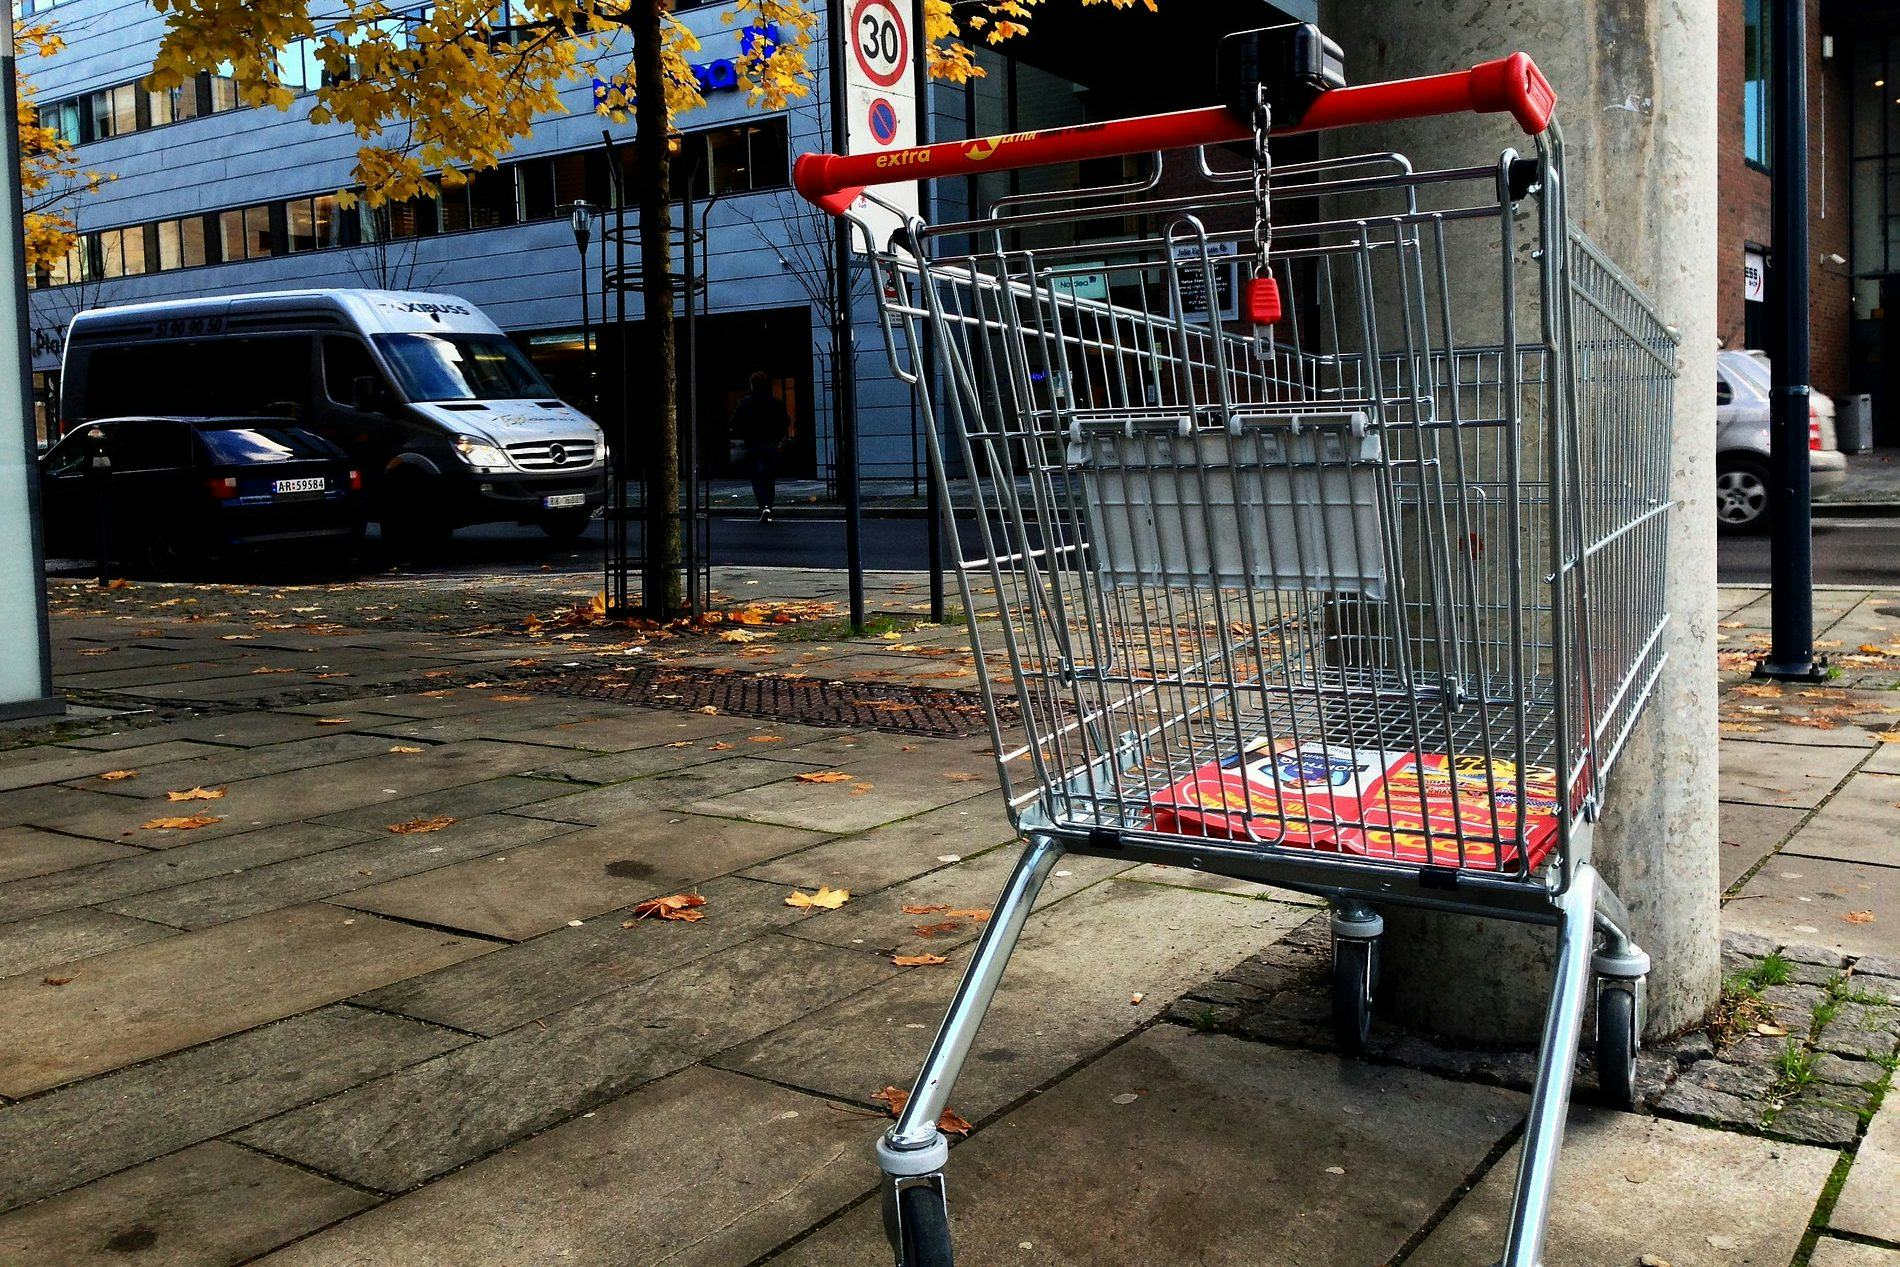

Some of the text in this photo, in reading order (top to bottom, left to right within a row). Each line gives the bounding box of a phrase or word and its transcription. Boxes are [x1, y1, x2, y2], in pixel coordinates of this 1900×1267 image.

[861, 13, 898, 65] 30
[876, 148, 931, 168] extra
[1060, 280, 1089, 289] Nodea
[378, 302, 471, 316] XIBUSS
[278, 479, 324, 492] AR 59584
